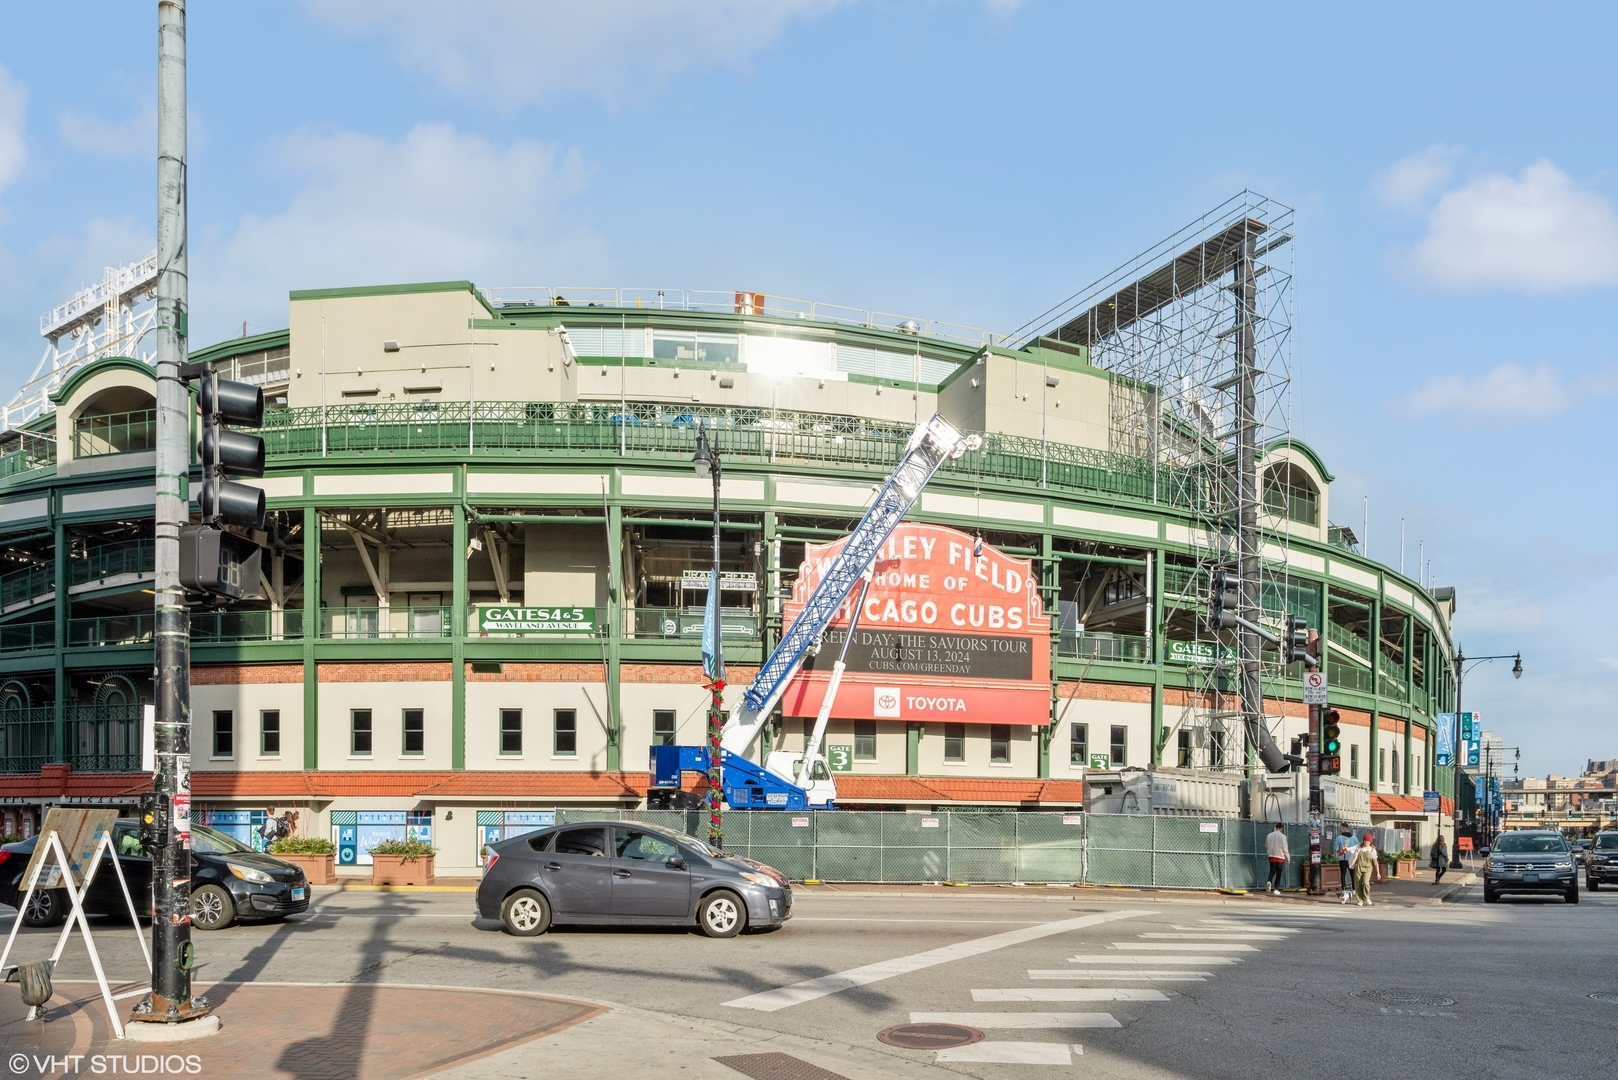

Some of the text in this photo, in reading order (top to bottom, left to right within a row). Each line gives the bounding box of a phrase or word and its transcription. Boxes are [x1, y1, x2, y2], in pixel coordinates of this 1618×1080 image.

[949, 541, 1022, 594] FIELD
[726, 572, 756, 580] BEER
[875, 572, 969, 592] HOME OF
[485, 608, 550, 621] GATES
[950, 602, 1024, 630] CUBS
[862, 632, 894, 647] DAY:
[897, 634, 926, 648] THE
[930, 636, 988, 652] SAVIORS
[991, 639, 1028, 654] TOUR
[871, 647, 970, 663] AUGUST 13, 2024
[869, 660, 971, 674] CUBS.COM/GREENDAY
[906, 696, 967, 711] TOYOTA
[832, 751, 848, 766] 3
[1332, 757, 1340, 769] 12
